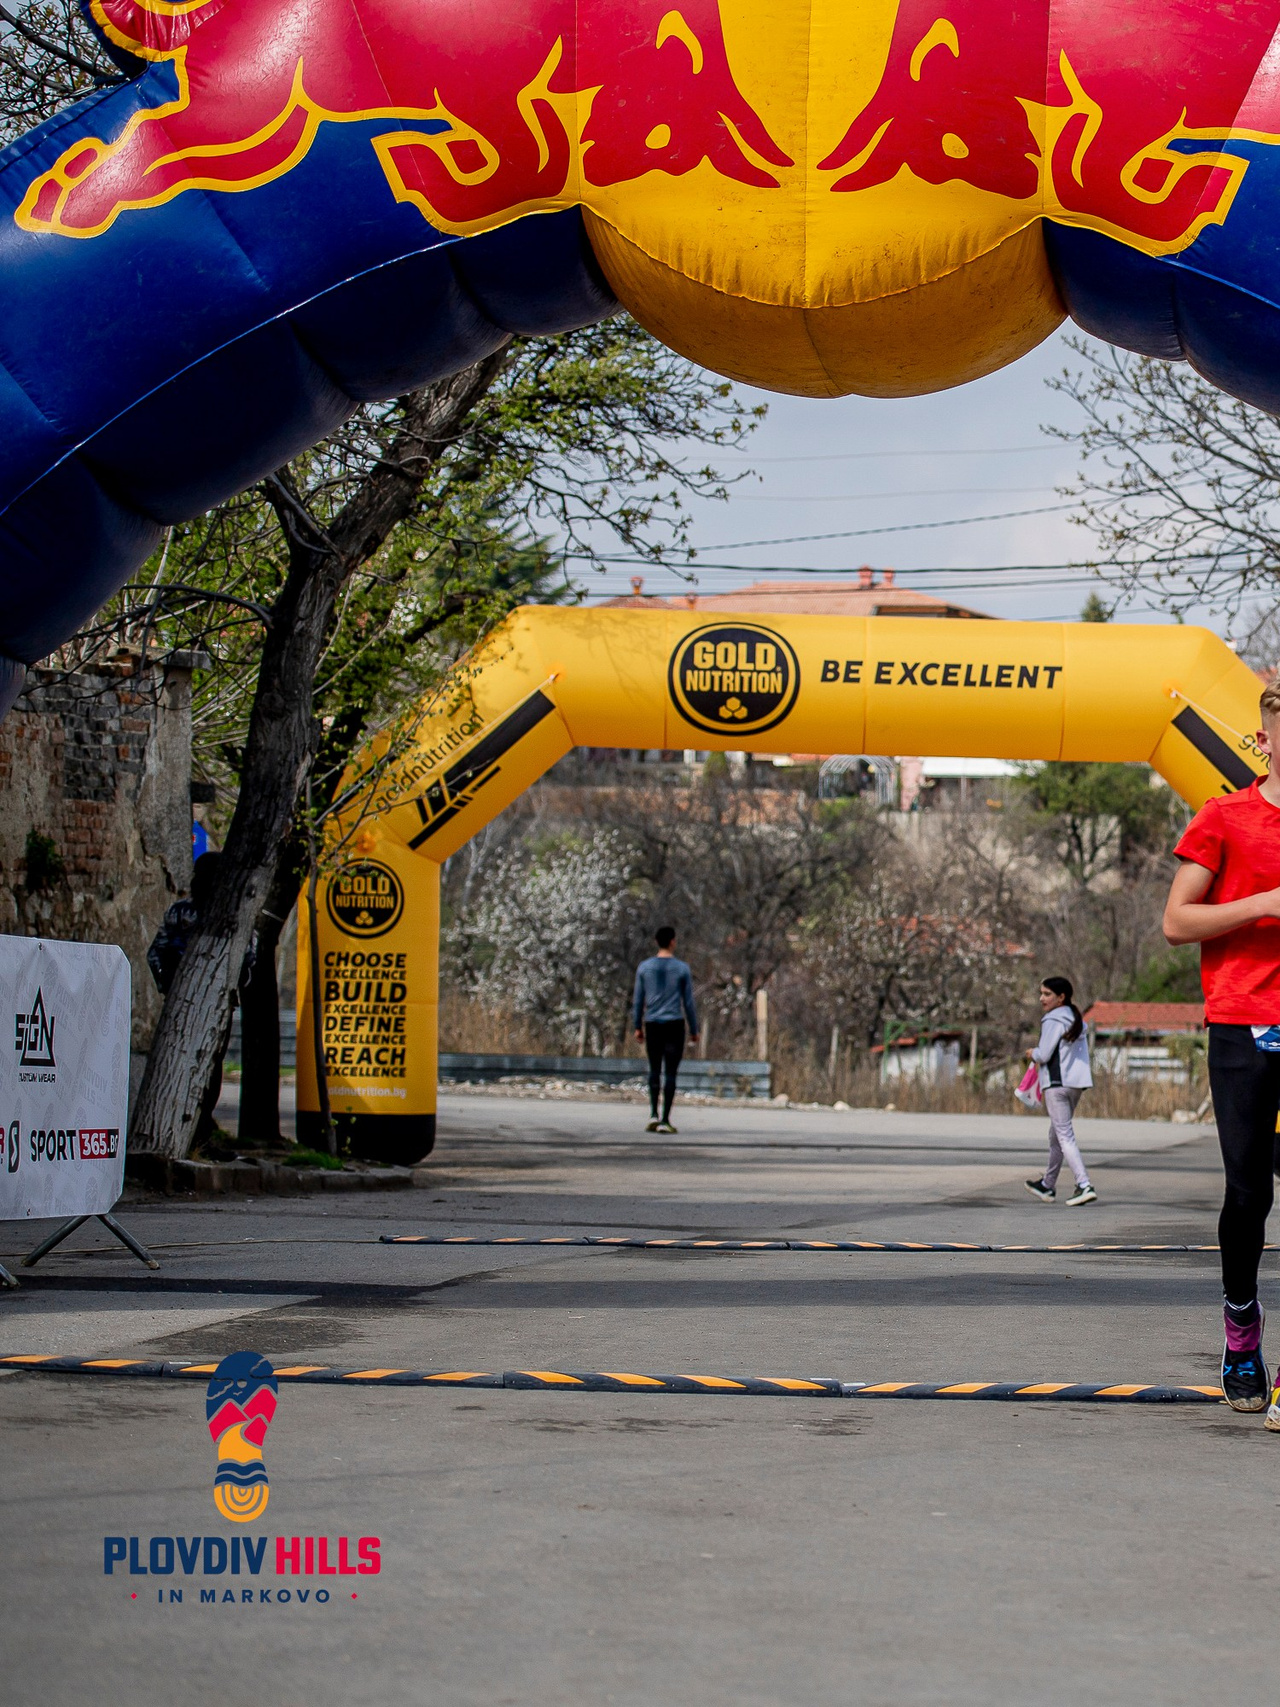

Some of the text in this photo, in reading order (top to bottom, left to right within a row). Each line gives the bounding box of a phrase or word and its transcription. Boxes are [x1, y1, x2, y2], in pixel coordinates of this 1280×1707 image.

[693, 640, 779, 671] GOLD
[685, 669, 783, 694] NUTRITION
[820, 660, 1063, 689] BE EXCELLENT
[340, 875, 390, 895] GOLD
[335, 894, 394, 909] NUTRITION
[324, 952, 407, 968] CHOOSE
[324, 969, 406, 981] EXCELLENCE
[324, 981, 407, 1003] BUILD
[324, 1003, 406, 1016] EXCELLENCE
[324, 1016, 406, 1033] DEFINE
[324, 1033, 406, 1045] EXCELLENCE
[325, 1046, 406, 1066] REACH
[325, 1066, 406, 1078] EXCELLENCE
[30, 1129, 76, 1162] SPORT
